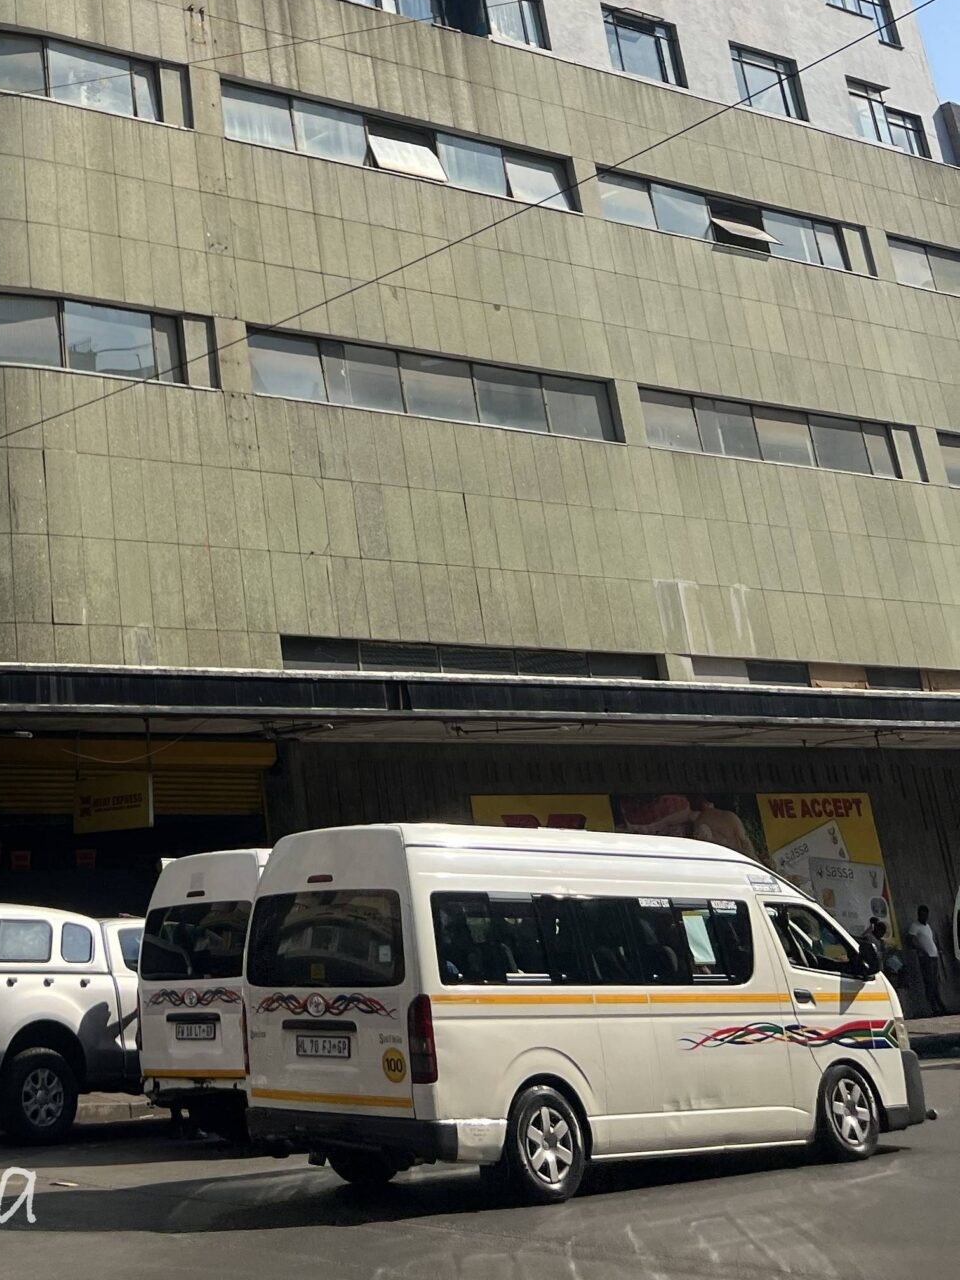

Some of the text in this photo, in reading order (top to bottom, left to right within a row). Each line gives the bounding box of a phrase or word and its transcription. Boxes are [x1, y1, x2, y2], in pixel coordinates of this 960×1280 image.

[112, 793, 143, 806] EXPRESS
[768, 798, 862, 818] WE ACCEPT
[785, 842, 809, 863] sassa
[825, 866, 854, 879] sassa
[385, 1058, 403, 1072] 100
